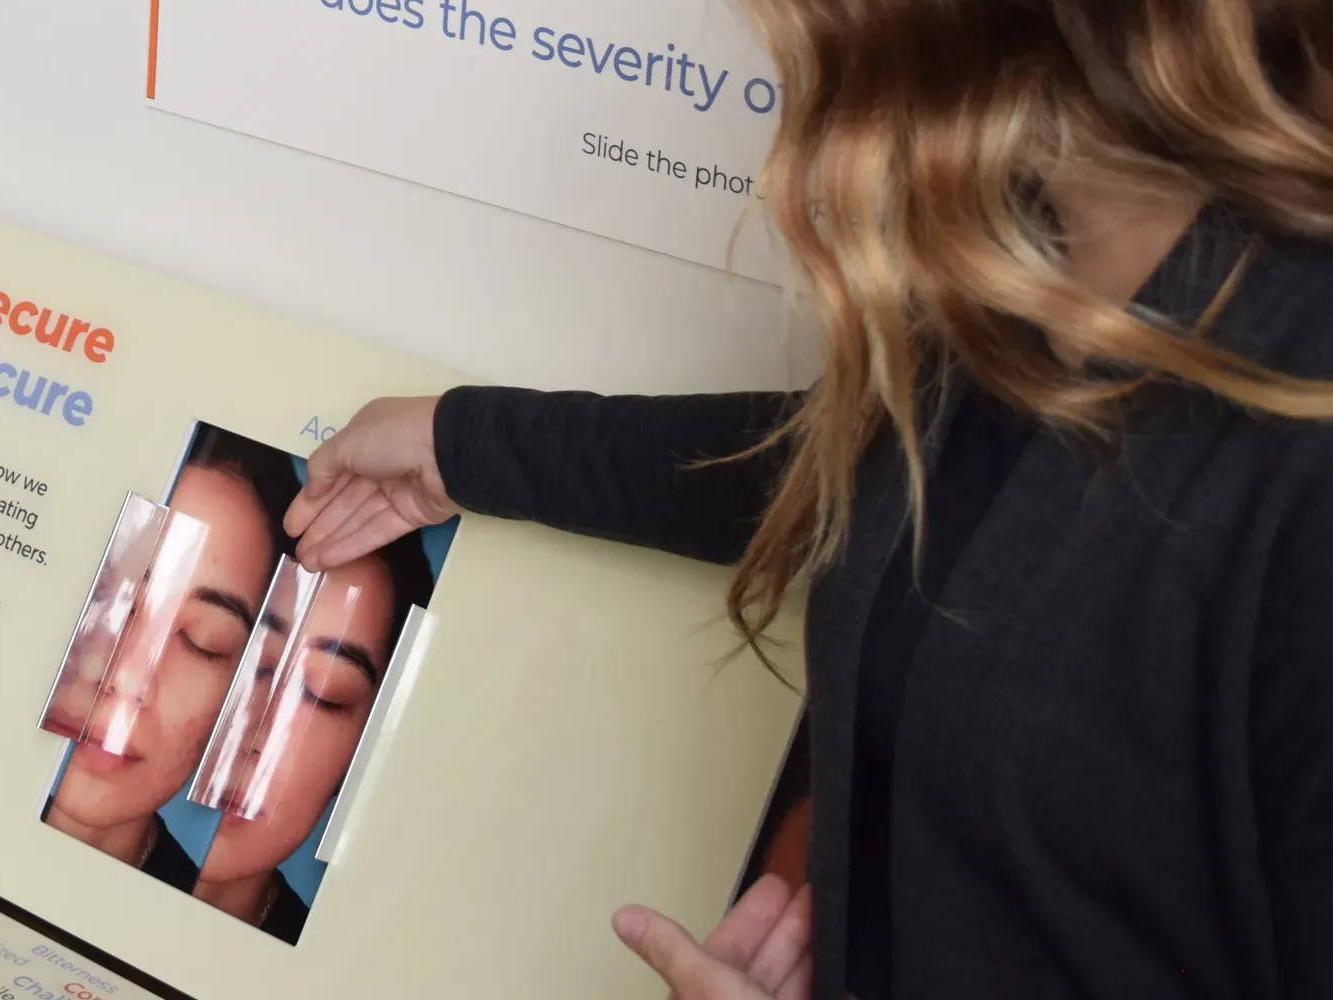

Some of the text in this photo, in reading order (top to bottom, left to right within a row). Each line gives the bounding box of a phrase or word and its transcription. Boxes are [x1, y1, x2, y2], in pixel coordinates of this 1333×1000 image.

[531, 25, 729, 112] severity
[744, 77, 786, 114] o
[582, 132, 767, 200] Slide the phot
[23, 475, 48, 496] we
[31, 943, 118, 994] Bitterness
